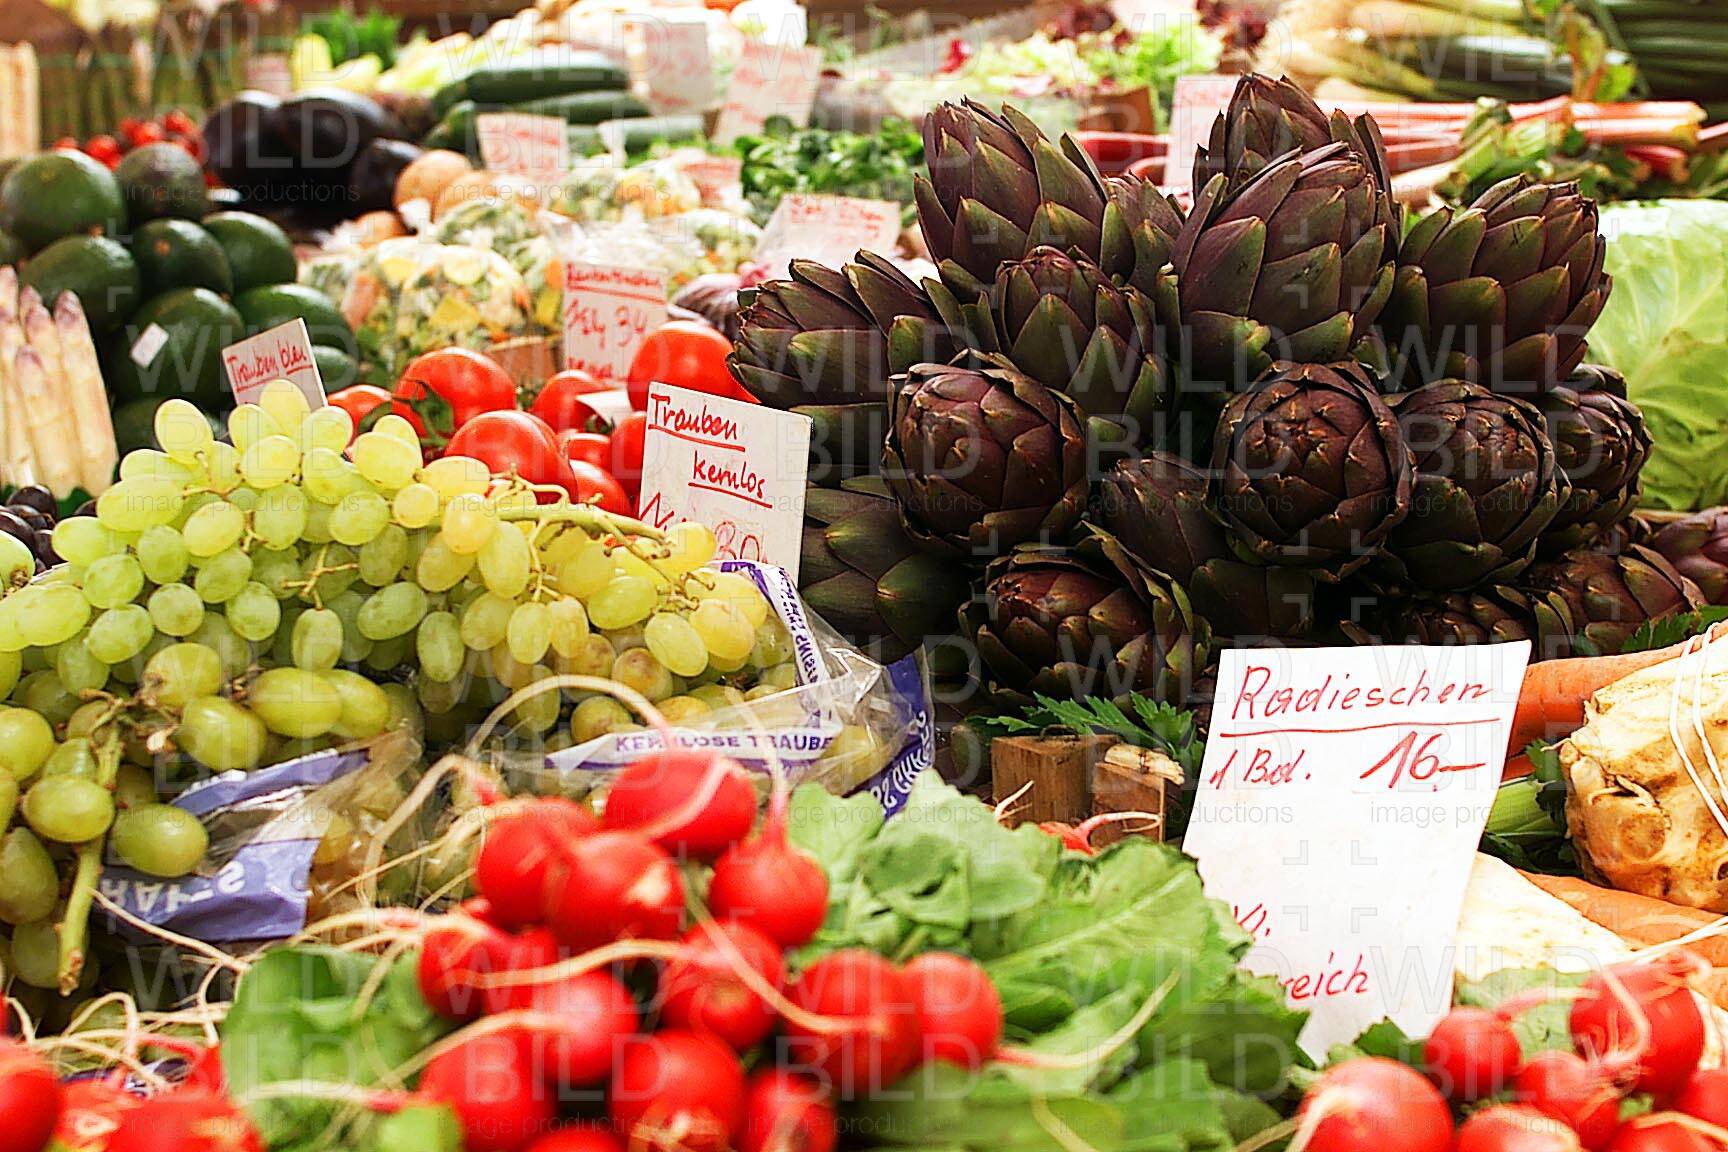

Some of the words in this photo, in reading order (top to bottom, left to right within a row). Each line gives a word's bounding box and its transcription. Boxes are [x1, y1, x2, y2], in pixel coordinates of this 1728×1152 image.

[650, 393, 738, 441] Trauben
[692, 450, 766, 499] kernlos
[1232, 664, 1494, 720] Radieschen
[615, 734, 741, 753] KERLOSE
